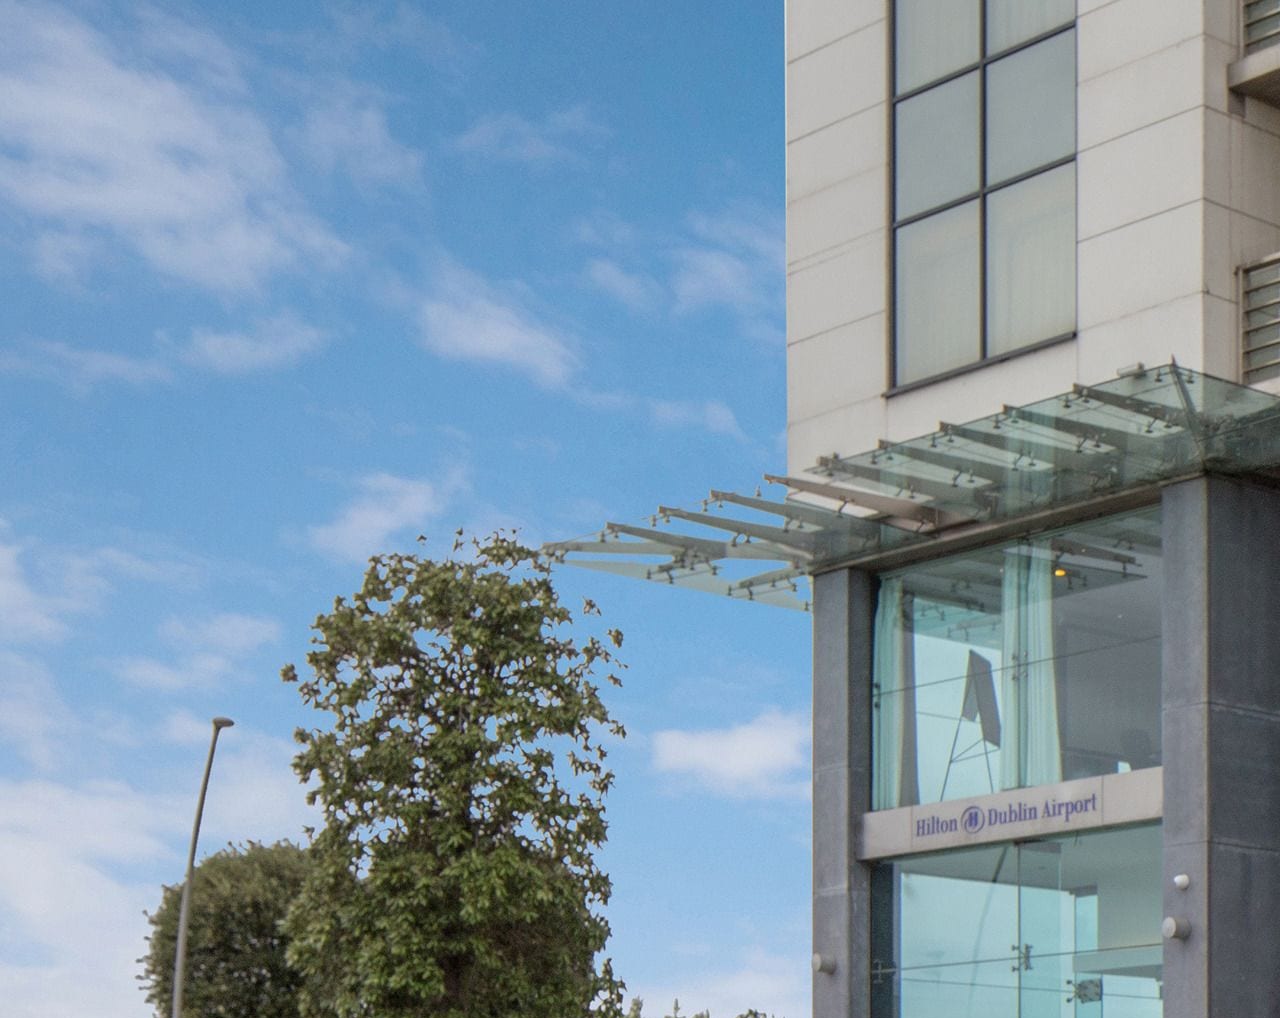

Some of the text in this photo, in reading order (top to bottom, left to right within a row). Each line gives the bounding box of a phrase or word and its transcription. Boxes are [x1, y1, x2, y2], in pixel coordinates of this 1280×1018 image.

[915, 816, 958, 837] Hilton
[987, 801, 1038, 827] Dublin
[1041, 793, 1097, 821] Airport
